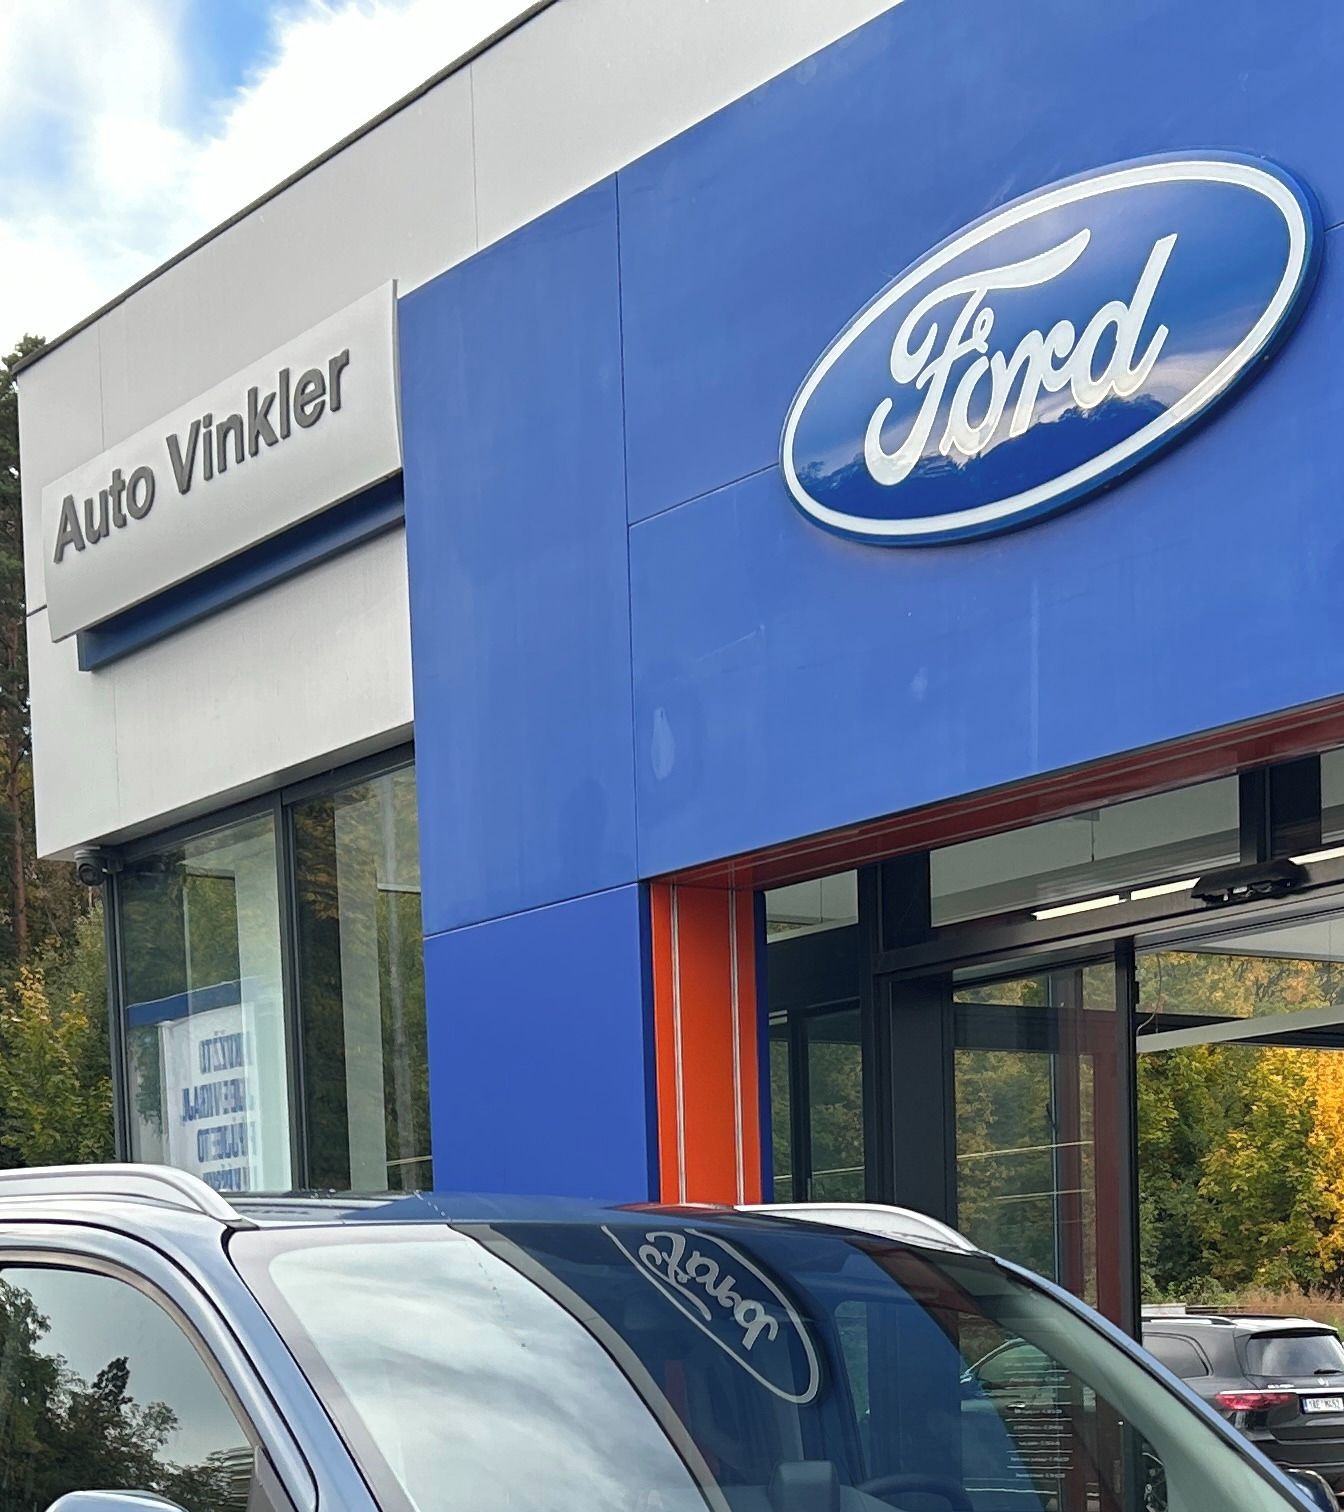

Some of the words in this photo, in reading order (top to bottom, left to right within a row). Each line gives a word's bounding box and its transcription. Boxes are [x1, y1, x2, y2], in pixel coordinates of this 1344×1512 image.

[53, 464, 155, 564] Auto
[166, 348, 350, 495] Vinkler
[864, 228, 1178, 486] Ford
